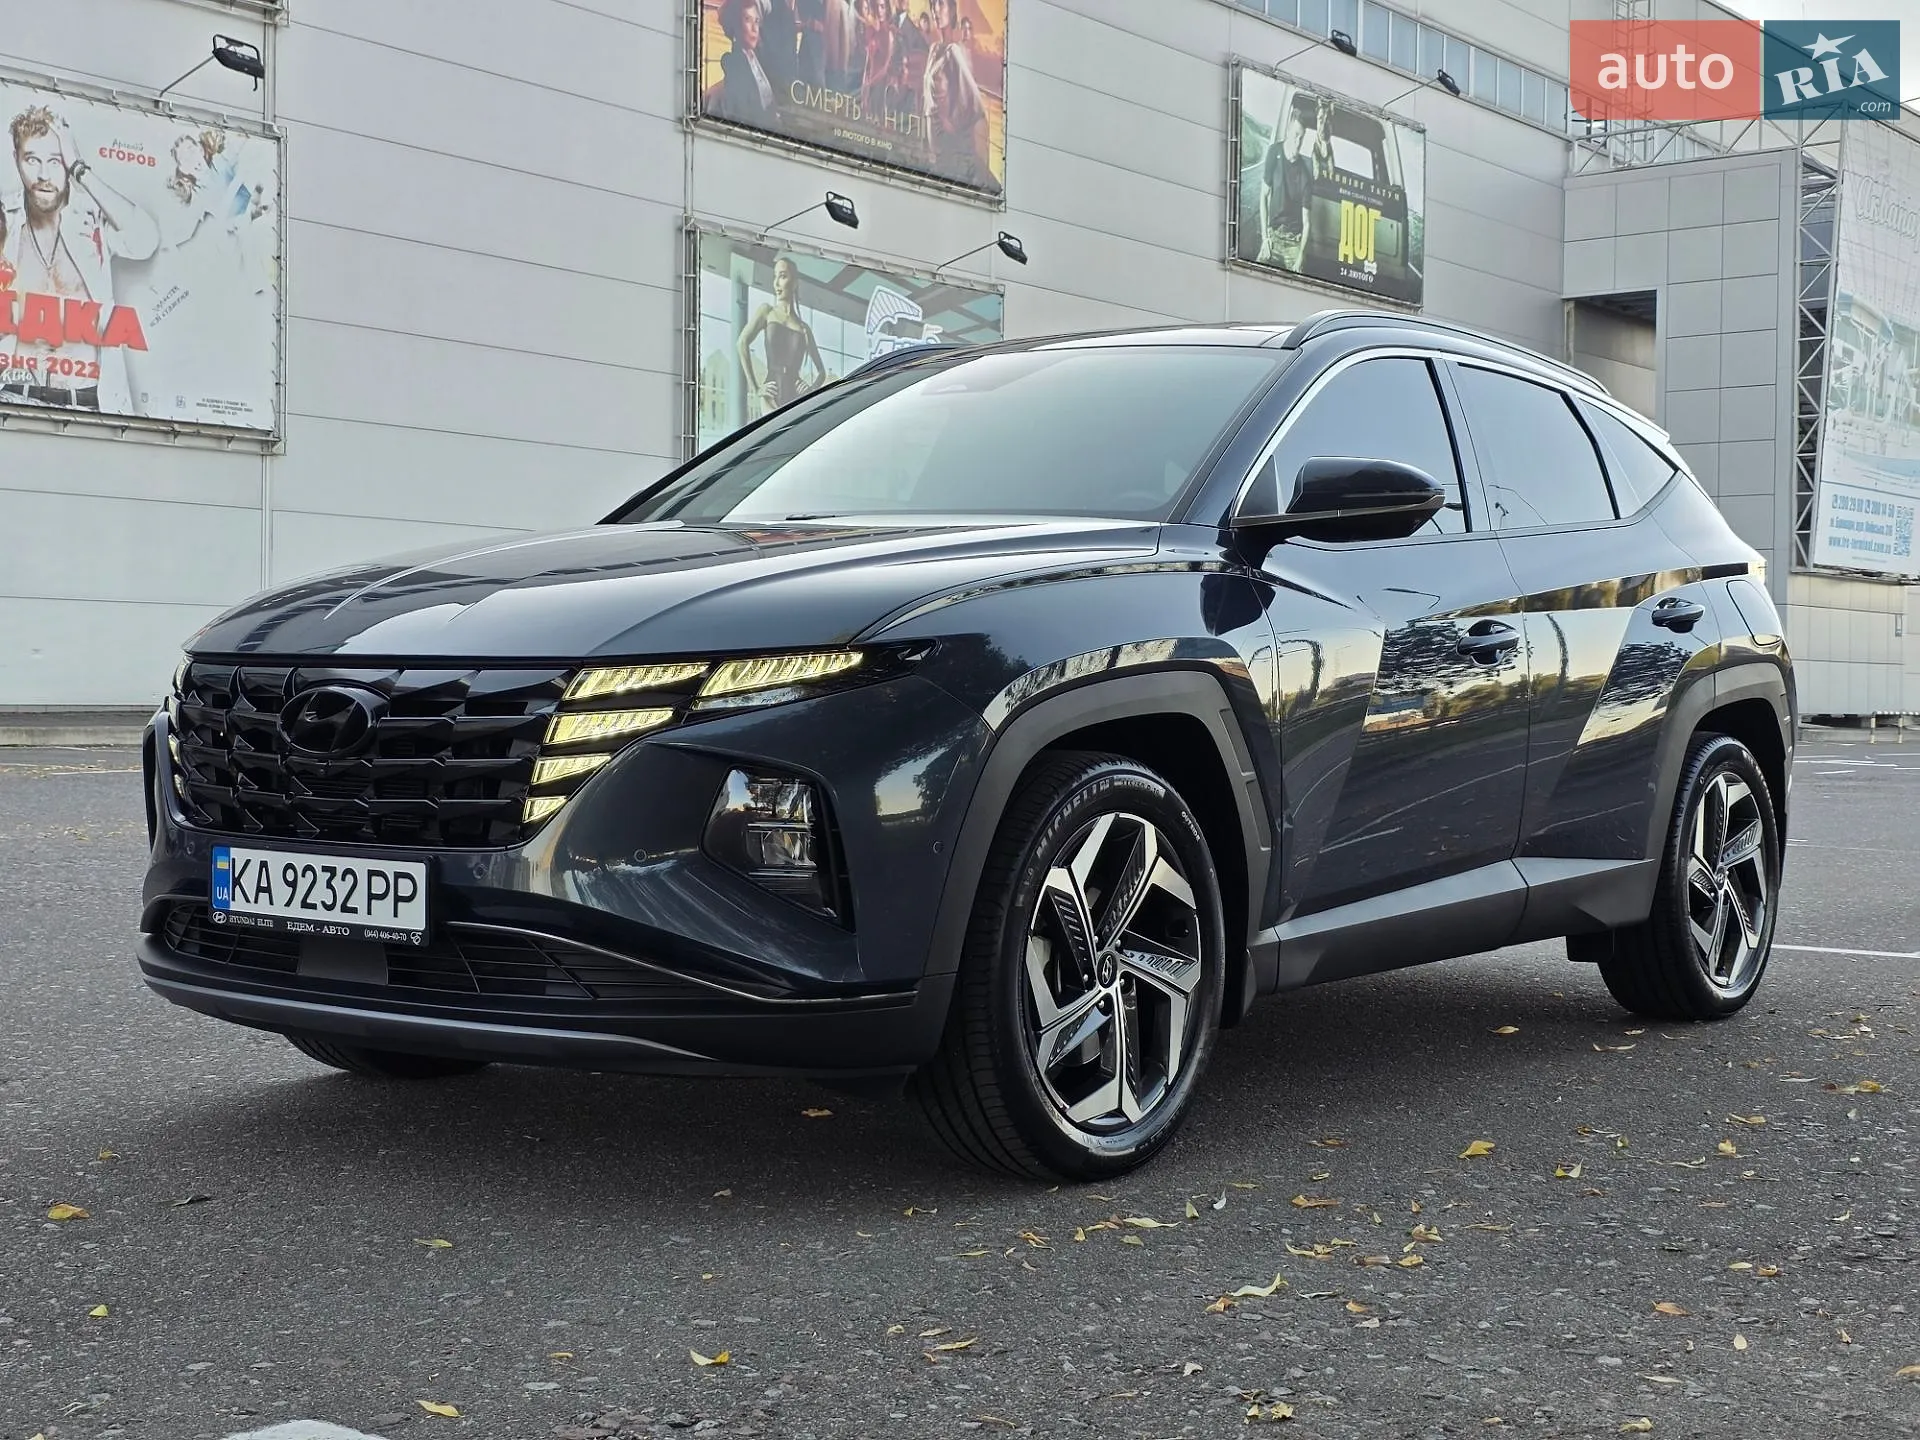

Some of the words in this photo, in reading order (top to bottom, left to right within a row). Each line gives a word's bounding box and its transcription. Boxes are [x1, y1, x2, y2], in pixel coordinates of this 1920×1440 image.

[790, 79, 861, 120] СМЕРТЬ
[98, 146, 156, 168] ЄГОРОВ
[1338, 199, 1382, 265] ДОГ
[44, 356, 100, 379] 2022
[216, 886, 229, 901] UA
[231, 857, 274, 906] KA
[281, 862, 359, 914] 9232
[366, 868, 418, 918] PP
[287, 921, 315, 933] ЕДЕМ
[321, 925, 350, 936] АВТО
